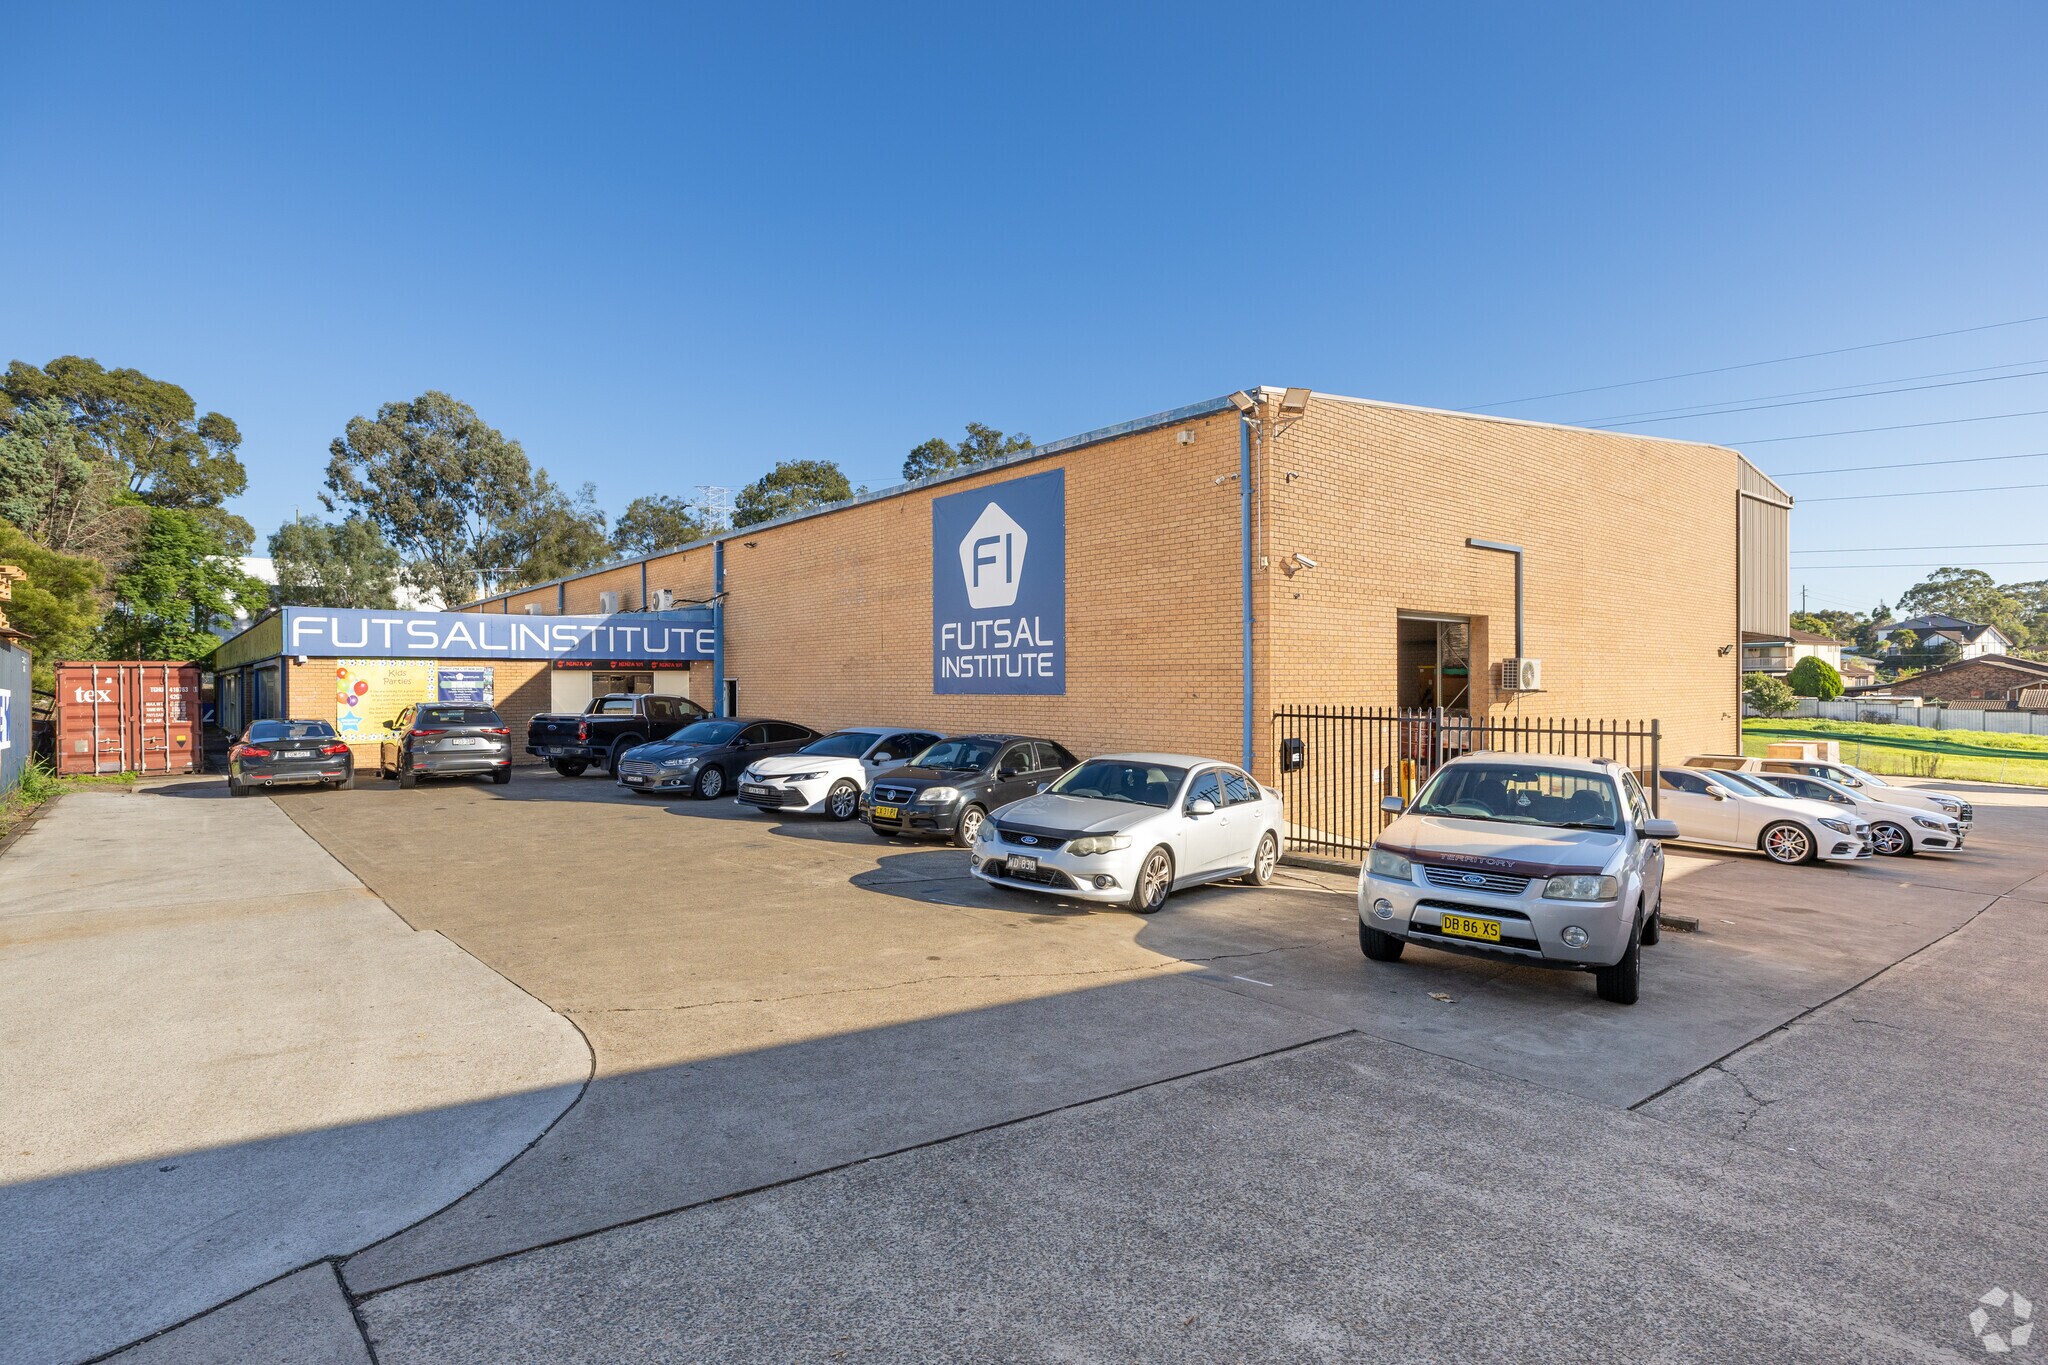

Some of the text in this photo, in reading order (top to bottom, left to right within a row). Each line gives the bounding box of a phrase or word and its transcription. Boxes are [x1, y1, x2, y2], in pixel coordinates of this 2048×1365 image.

[941, 616, 1053, 651] FUTSAL
[388, 669, 407, 677] Kids
[941, 652, 1054, 678] INSTITUTE
[383, 677, 412, 685] Parties
[74, 686, 112, 703] tex
[1440, 853, 1516, 868] TERRITORY
